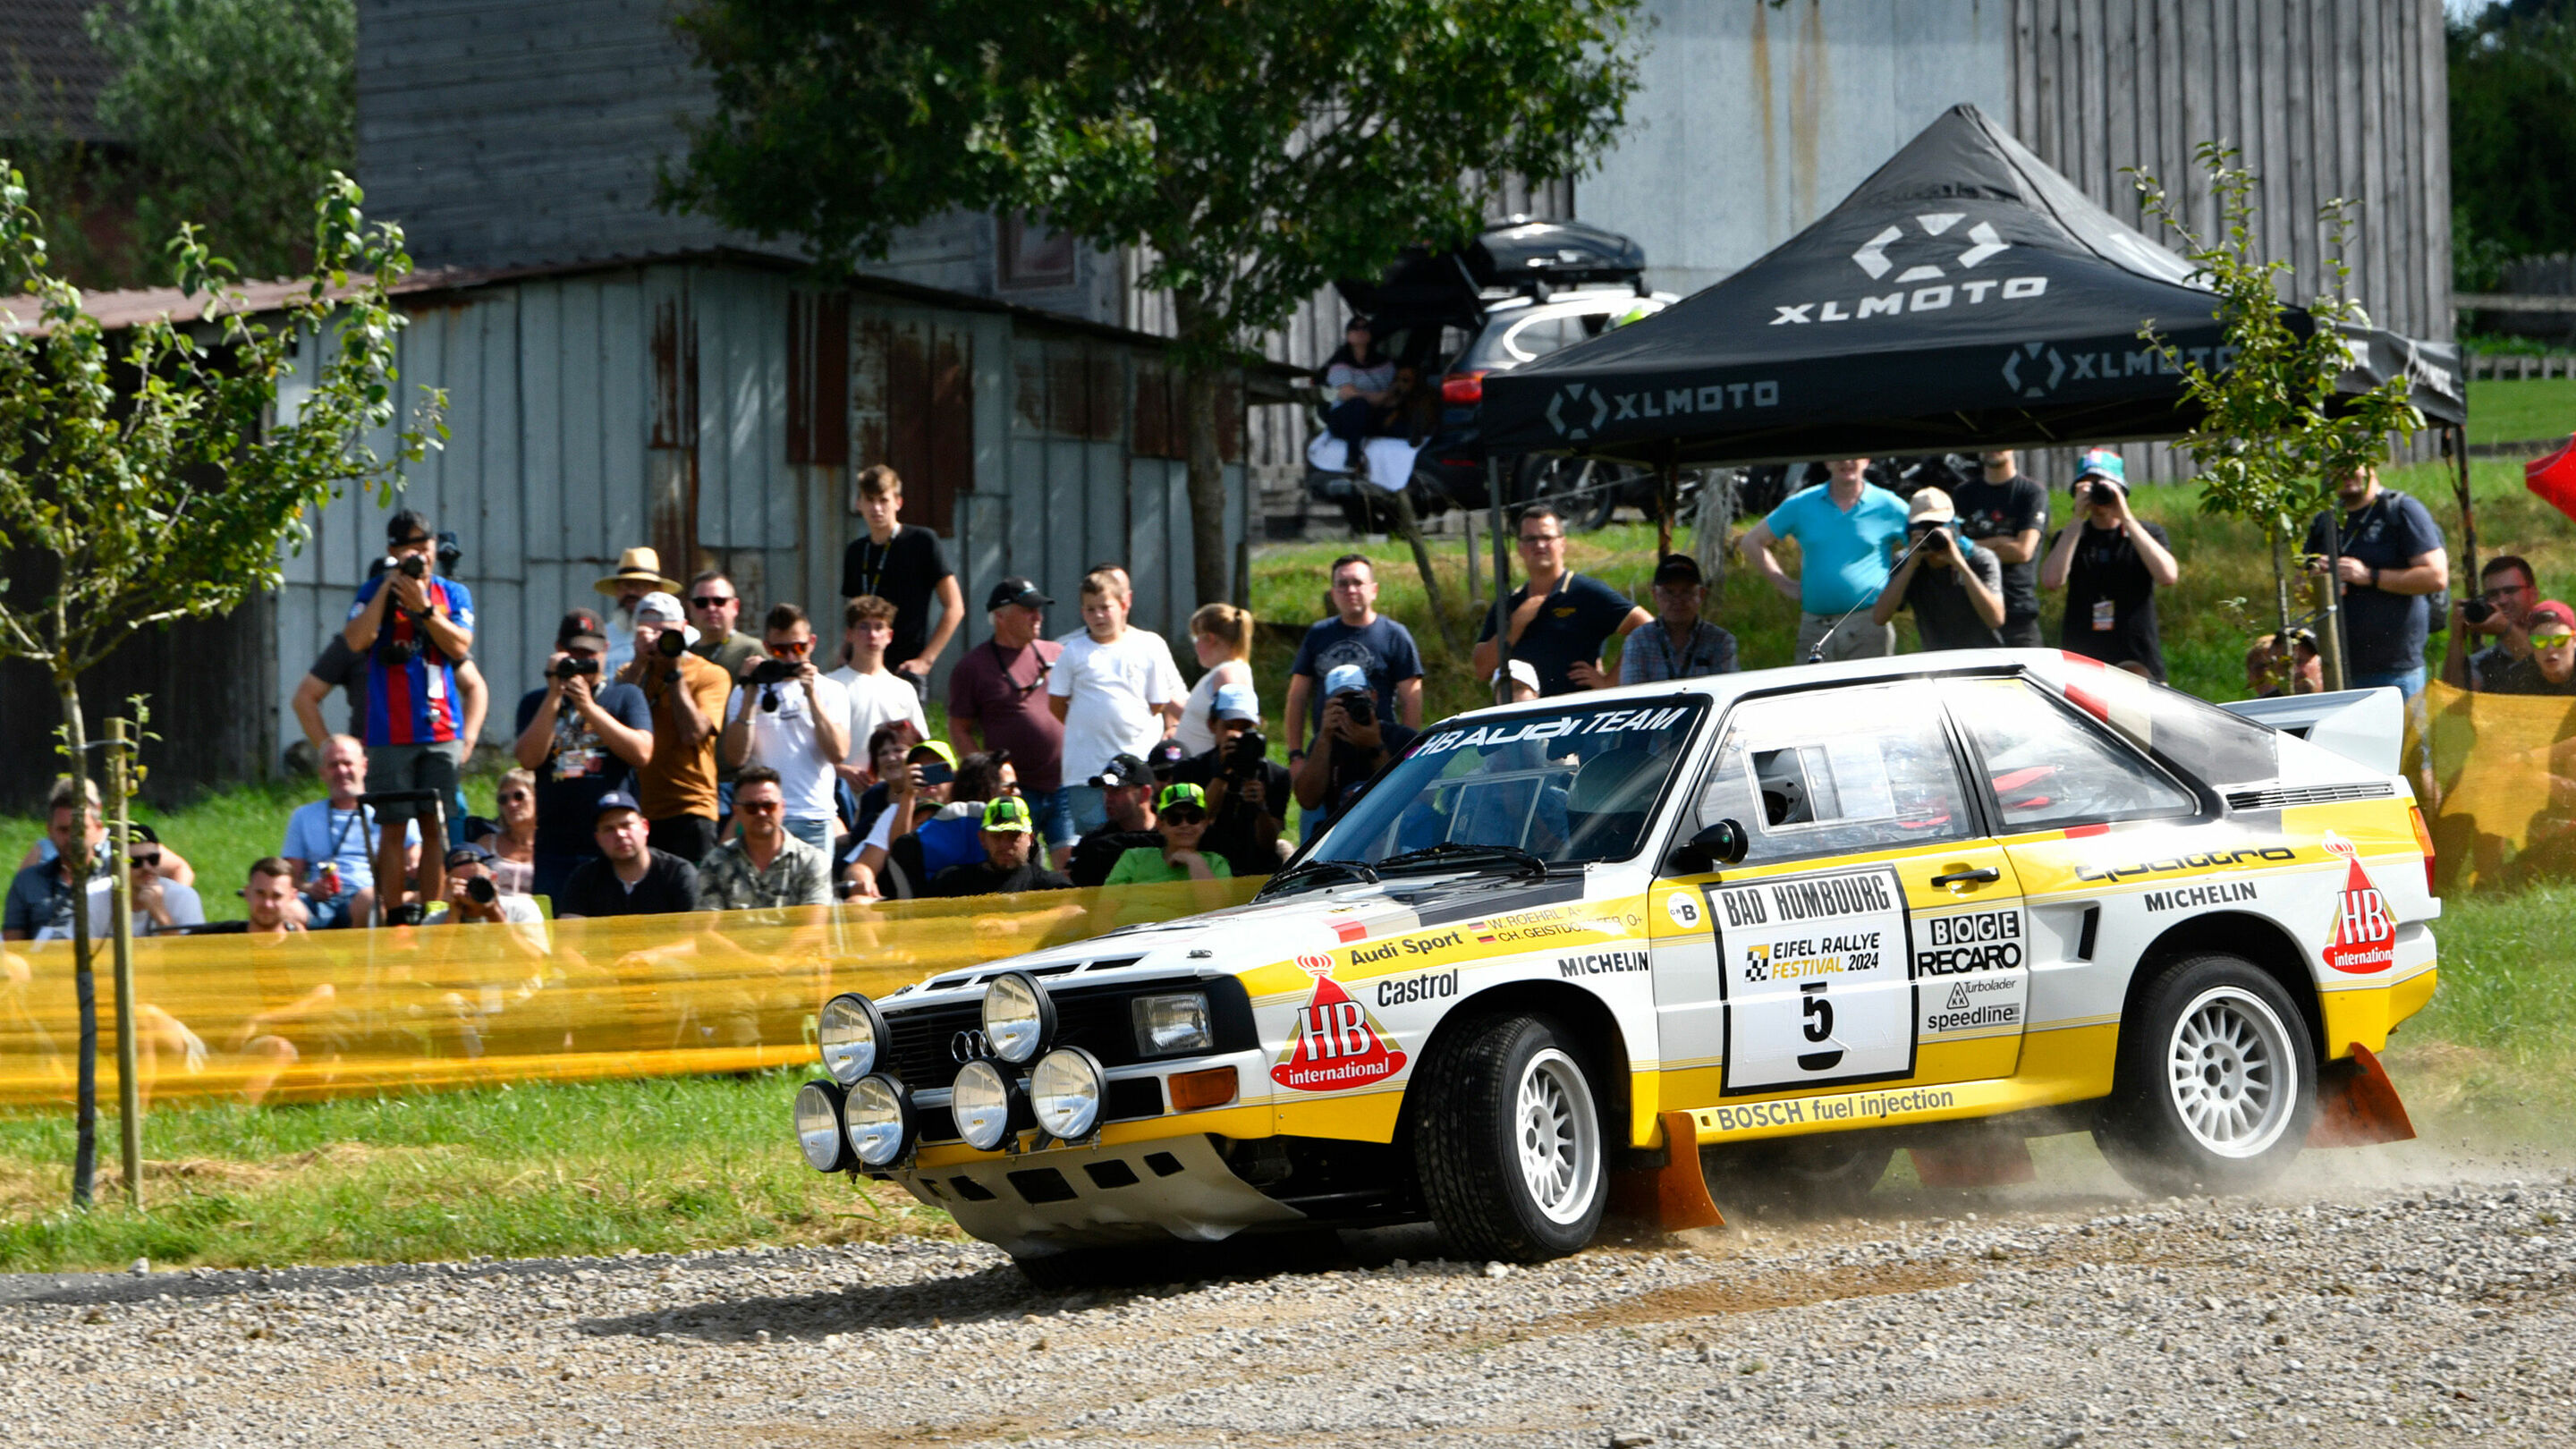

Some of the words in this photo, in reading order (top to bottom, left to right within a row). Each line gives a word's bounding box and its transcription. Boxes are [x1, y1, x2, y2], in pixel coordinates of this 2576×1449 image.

[1768, 276, 2048, 326] XLMOTO
[1614, 380, 1779, 420] XLMOTO
[1409, 729, 1468, 759] HB
[1580, 707, 1690, 734] TEAM
[1682, 904, 1697, 920] B
[1720, 888, 1768, 928] BAD
[1770, 874, 1893, 921] HOMBOURG
[2144, 881, 2258, 912] MICHELIN
[1508, 908, 1563, 927] ROEHRL
[1930, 911, 2021, 946] BOGE
[2336, 888, 2389, 945] HB
[1351, 945, 1399, 967] Audi
[1406, 930, 1464, 956] Sport
[1774, 939, 1817, 960] EIFEL
[1821, 932, 1880, 954] RALLYE
[1917, 943, 2022, 978] RECARO
[1557, 952, 1649, 978] MICHELIN
[1772, 956, 1844, 980] FESTIVAL
[1848, 952, 1879, 971] 2024
[1377, 969, 1459, 1007] Castrol
[1963, 978, 2016, 994] Turbolader
[1800, 981, 1834, 1043] 5
[1928, 1005, 2013, 1032] speedline
[1298, 999, 1372, 1062] HB
[1289, 1056, 1390, 1086] international
[1716, 1099, 1805, 1131] BOSCH
[1812, 1093, 1854, 1120] fuel
[1859, 1089, 1954, 1118] injection
